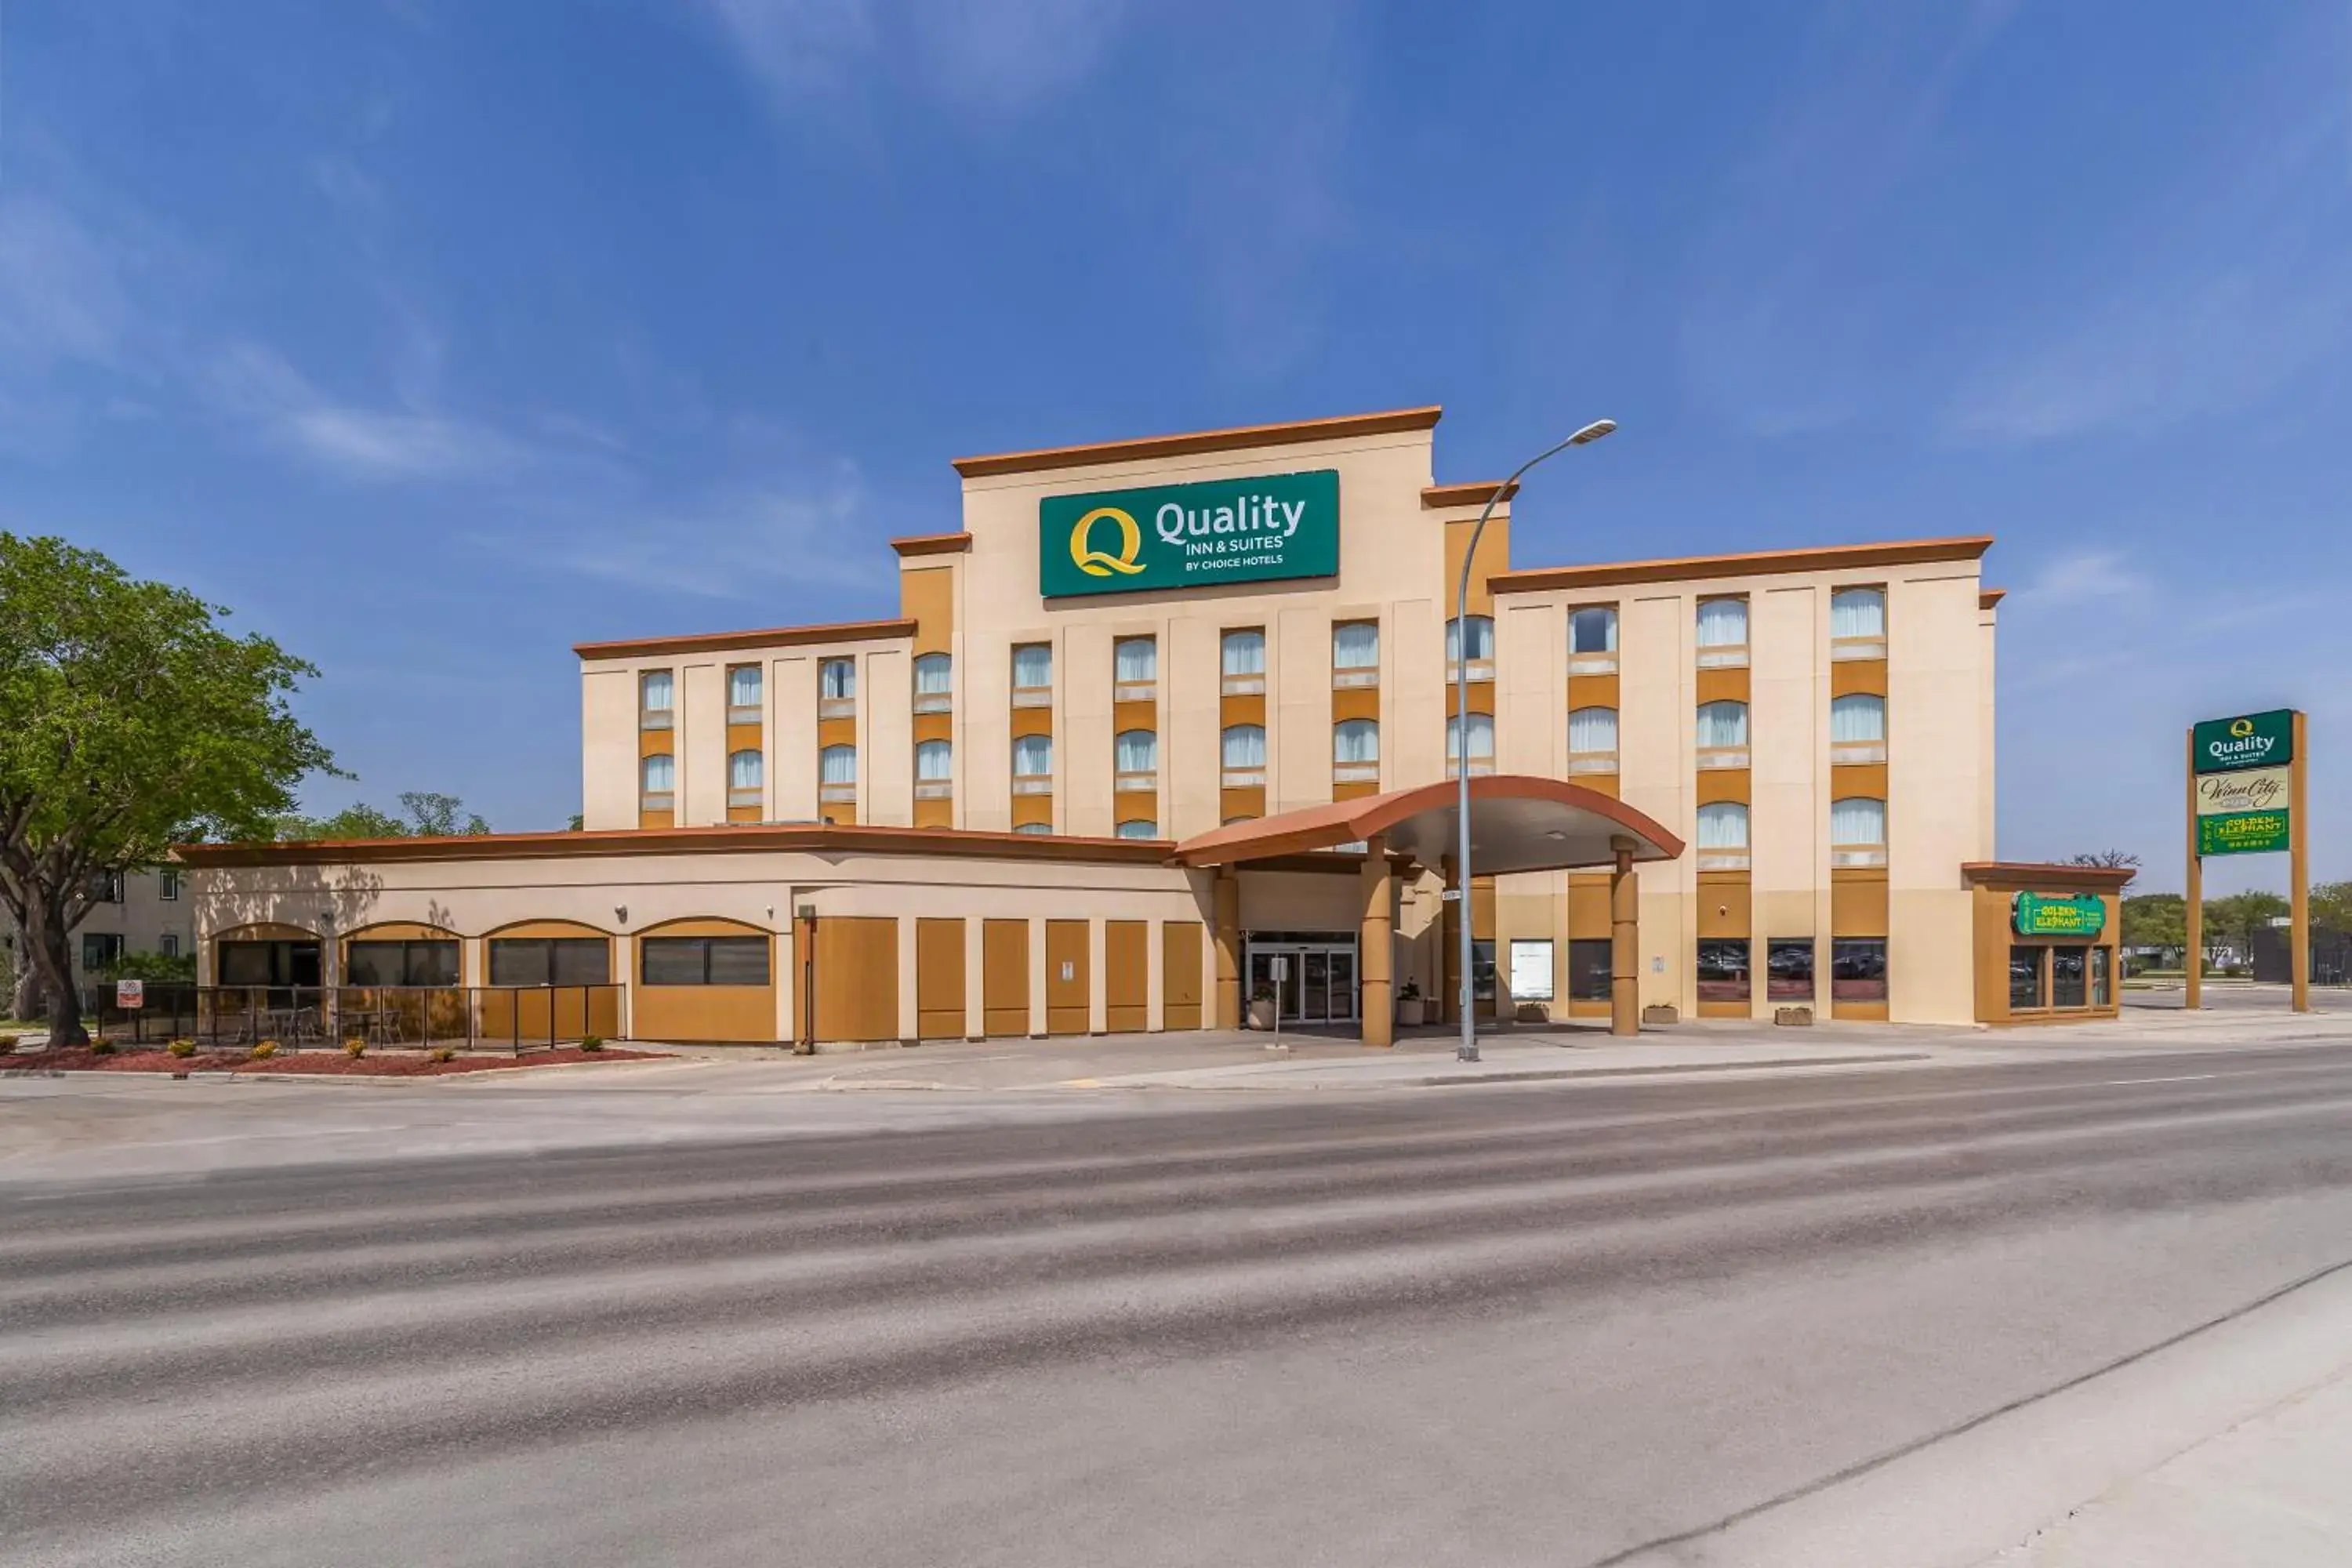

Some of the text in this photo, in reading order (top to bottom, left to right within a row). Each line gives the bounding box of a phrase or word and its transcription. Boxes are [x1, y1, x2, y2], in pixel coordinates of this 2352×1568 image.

[1156, 495, 1306, 546] Quality
[1069, 506, 1148, 577] Q
[1185, 535, 1284, 556] INN & SUITES
[1185, 554, 1284, 572] BY CHOICE HOTELS
[2209, 736, 2275, 757] Quality
[2248, 777, 2284, 808] City
[2227, 816, 2274, 827] GOLDEN
[2036, 916, 2082, 927] ELEPHANT
[2042, 906, 2077, 916] GOLDEN
